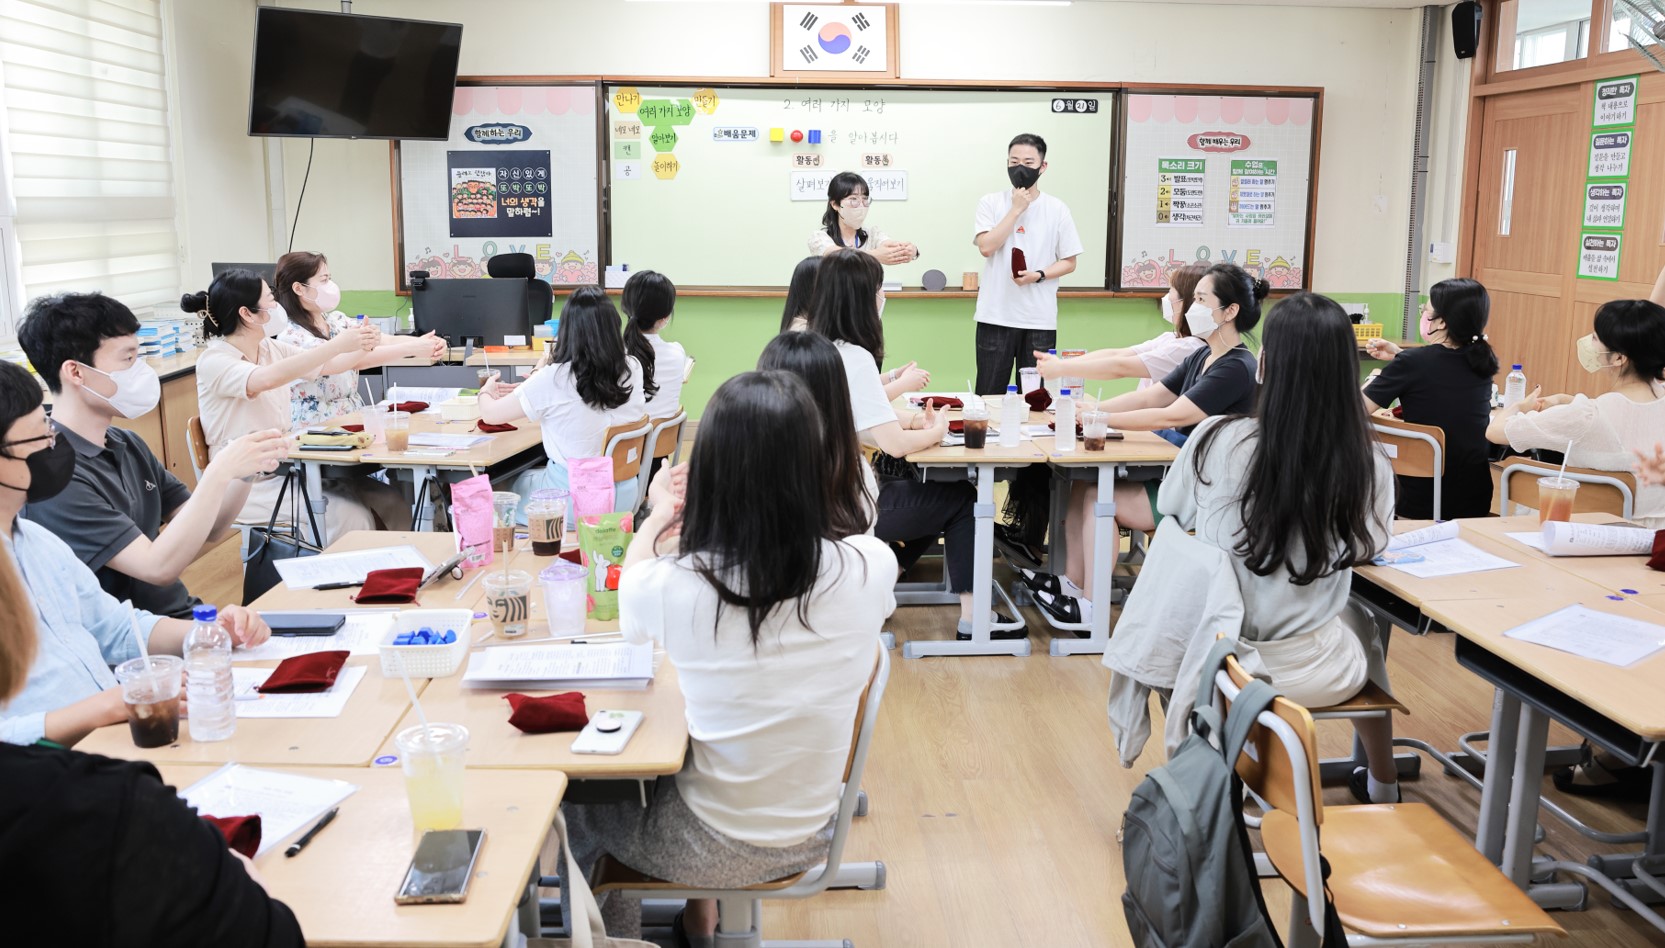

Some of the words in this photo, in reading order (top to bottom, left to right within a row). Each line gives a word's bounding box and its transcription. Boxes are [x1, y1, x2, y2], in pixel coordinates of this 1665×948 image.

[616, 92, 640, 106] 만나기
[694, 95, 716, 108] 만들기
[783, 98, 795, 110] 2.
[801, 98, 822, 113] 여러
[830, 98, 850, 112] 가지
[861, 98, 886, 114] 모양
[1608, 100, 1629, 110] 내용으로
[639, 105, 657, 119] 여러
[659, 106, 673, 117] 가지
[676, 103, 692, 117] 모양
[1600, 110, 1627, 121] 이야기하기
[474, 128, 505, 138] 함께하는
[507, 128, 522, 137] 우리
[615, 125, 627, 135] 네모
[628, 125, 640, 135] 네모
[723, 129, 757, 139] 배움문제
[651, 133, 676, 145] 알아보기
[828, 130, 838, 144] 을
[1199, 137, 1211, 146] 함께
[1212, 137, 1229, 146] 배우는
[1230, 137, 1241, 146] 우리
[796, 155, 813, 166] 활동
[865, 155, 882, 166] 활동
[1161, 161, 1185, 170] 목소리
[1187, 161, 1203, 170] 크기
[623, 165, 632, 176] 공
[1161, 174, 1167, 183] 3
[1160, 187, 1166, 195] 2
[1590, 188, 1610, 197] 생각하는
[501, 196, 519, 206] 너의
[521, 196, 545, 208] 생각을
[1160, 200, 1164, 208] 1
[506, 207, 541, 218] 말하렴~!
[1158, 212, 1164, 220] 0
